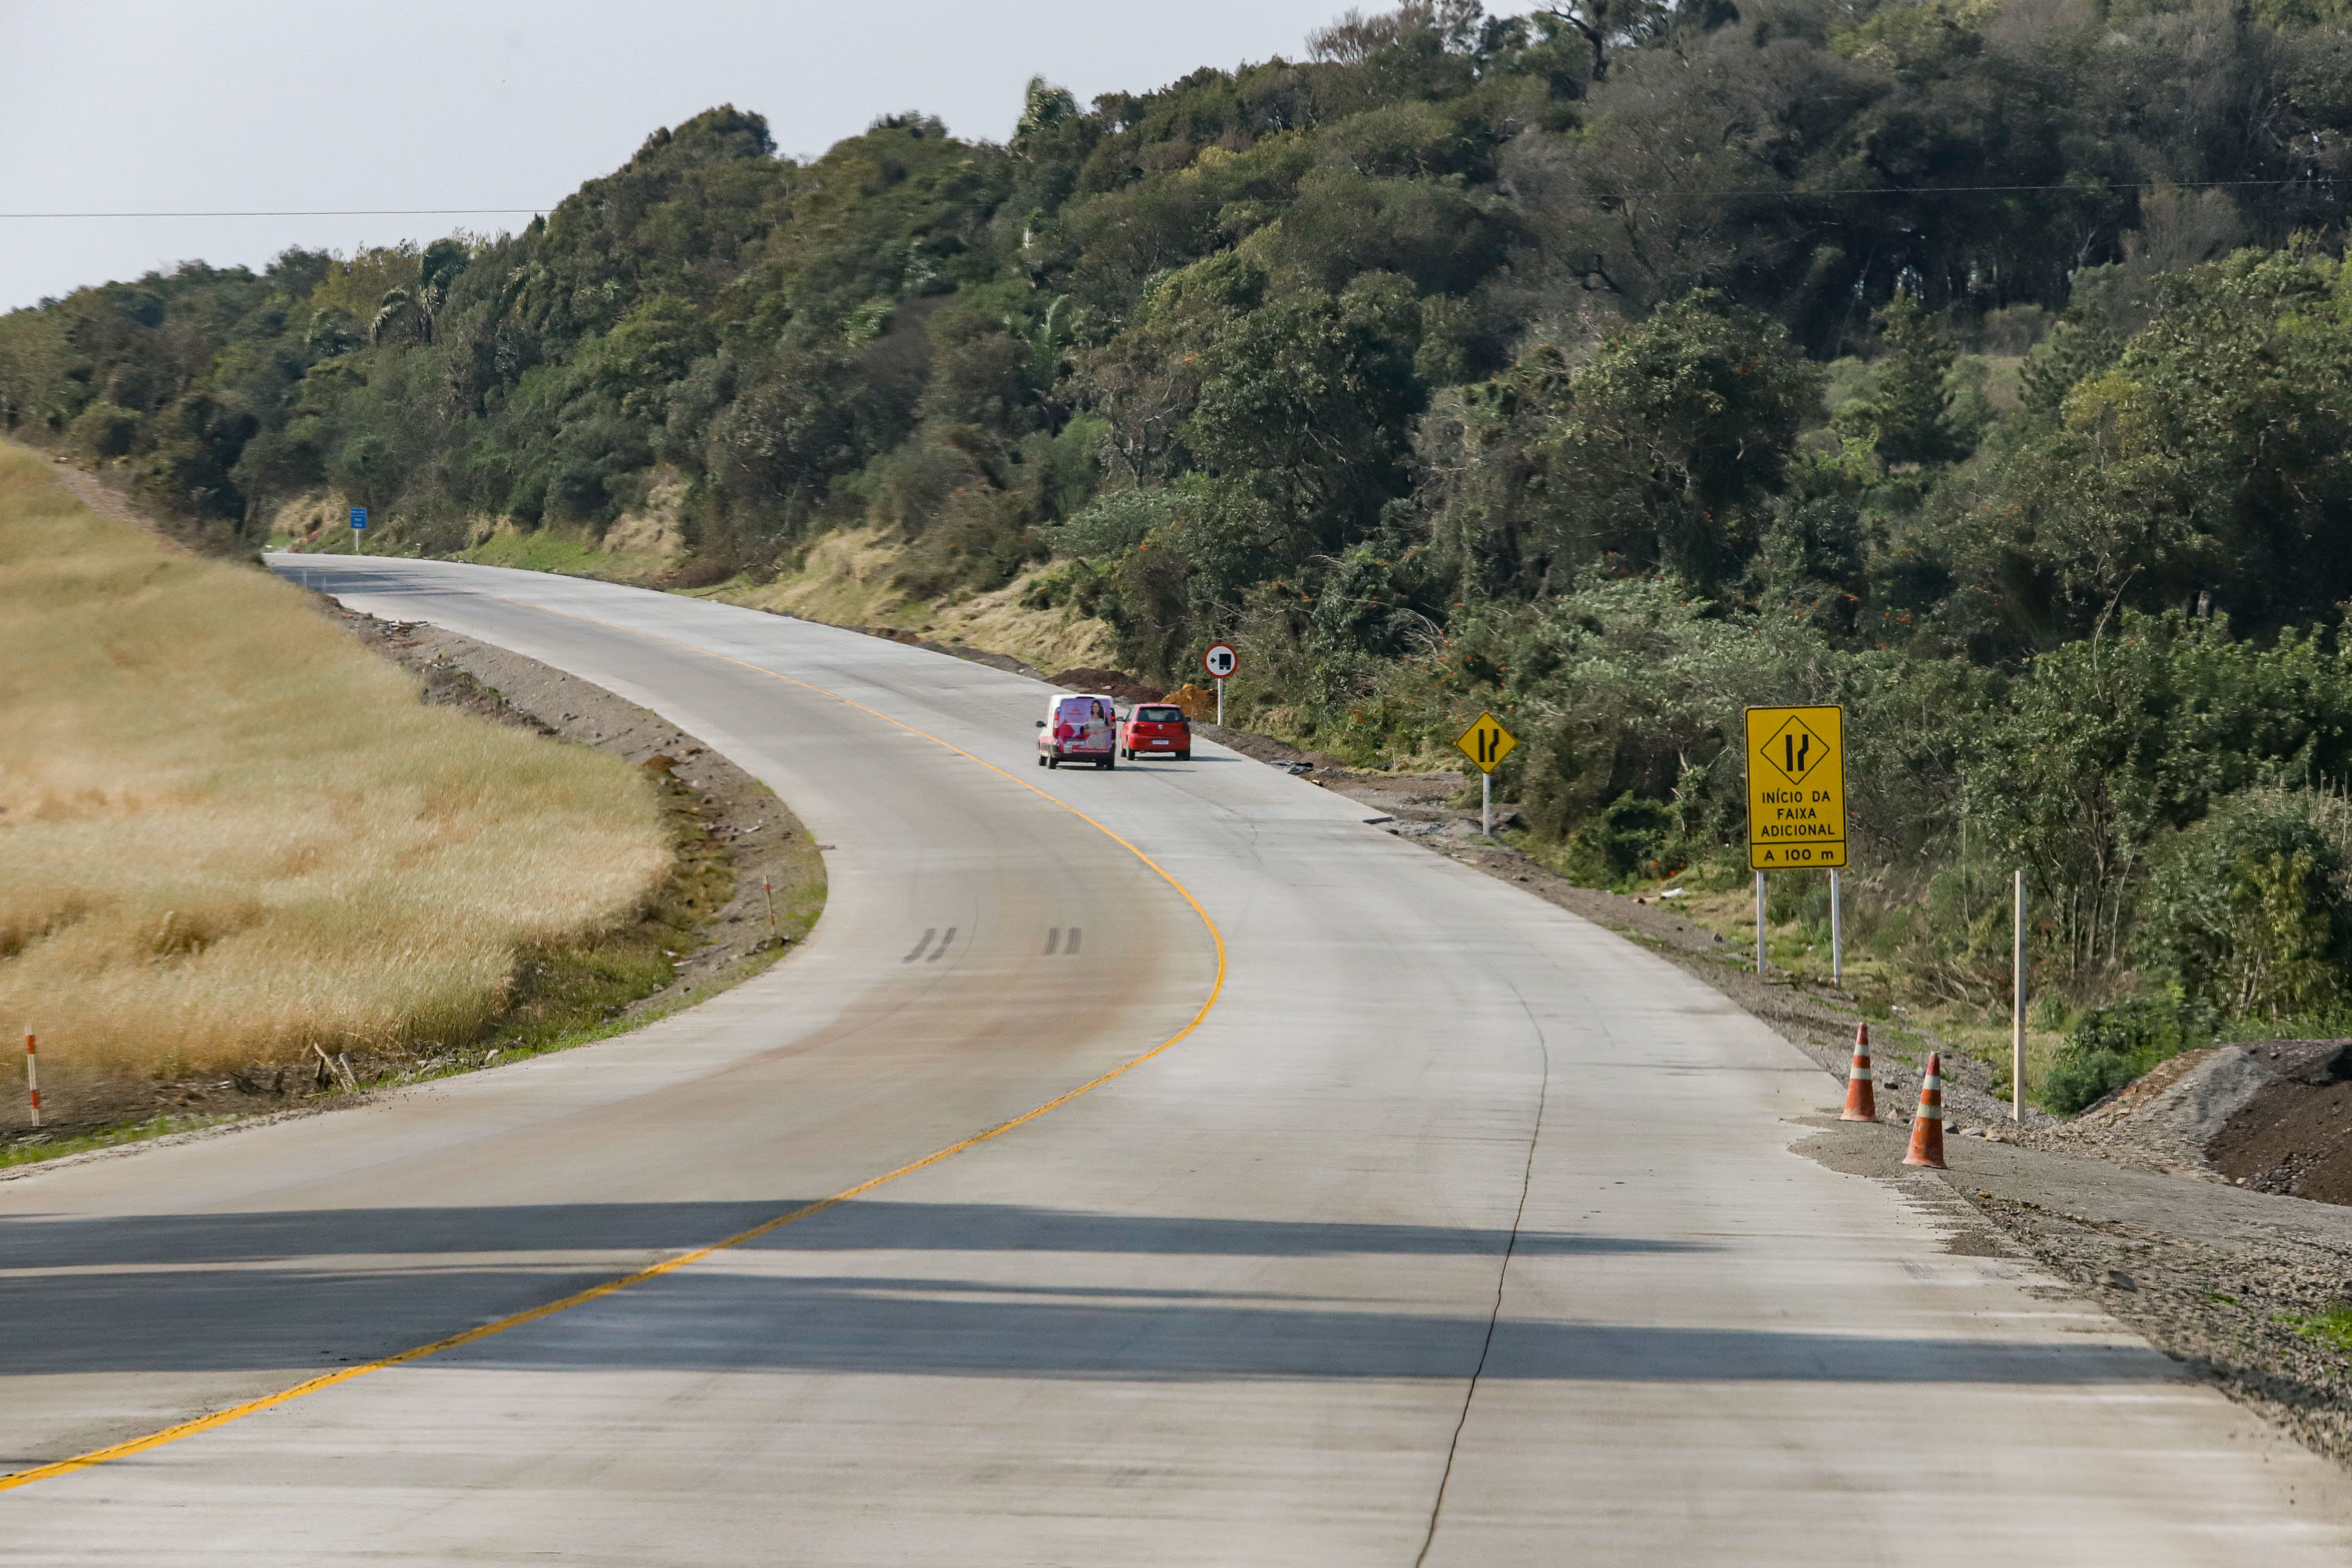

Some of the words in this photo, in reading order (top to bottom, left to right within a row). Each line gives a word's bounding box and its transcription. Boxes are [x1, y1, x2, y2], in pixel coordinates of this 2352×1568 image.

[1762, 788, 1802, 804] INÍCIO
[1813, 790, 1831, 802] DA
[1777, 808, 1817, 820] FAIXA
[1761, 824, 1835, 837] ADICIONAL
[1764, 849, 1775, 862] A
[1785, 849, 1811, 861] 100
[1821, 851, 1834, 860] m
